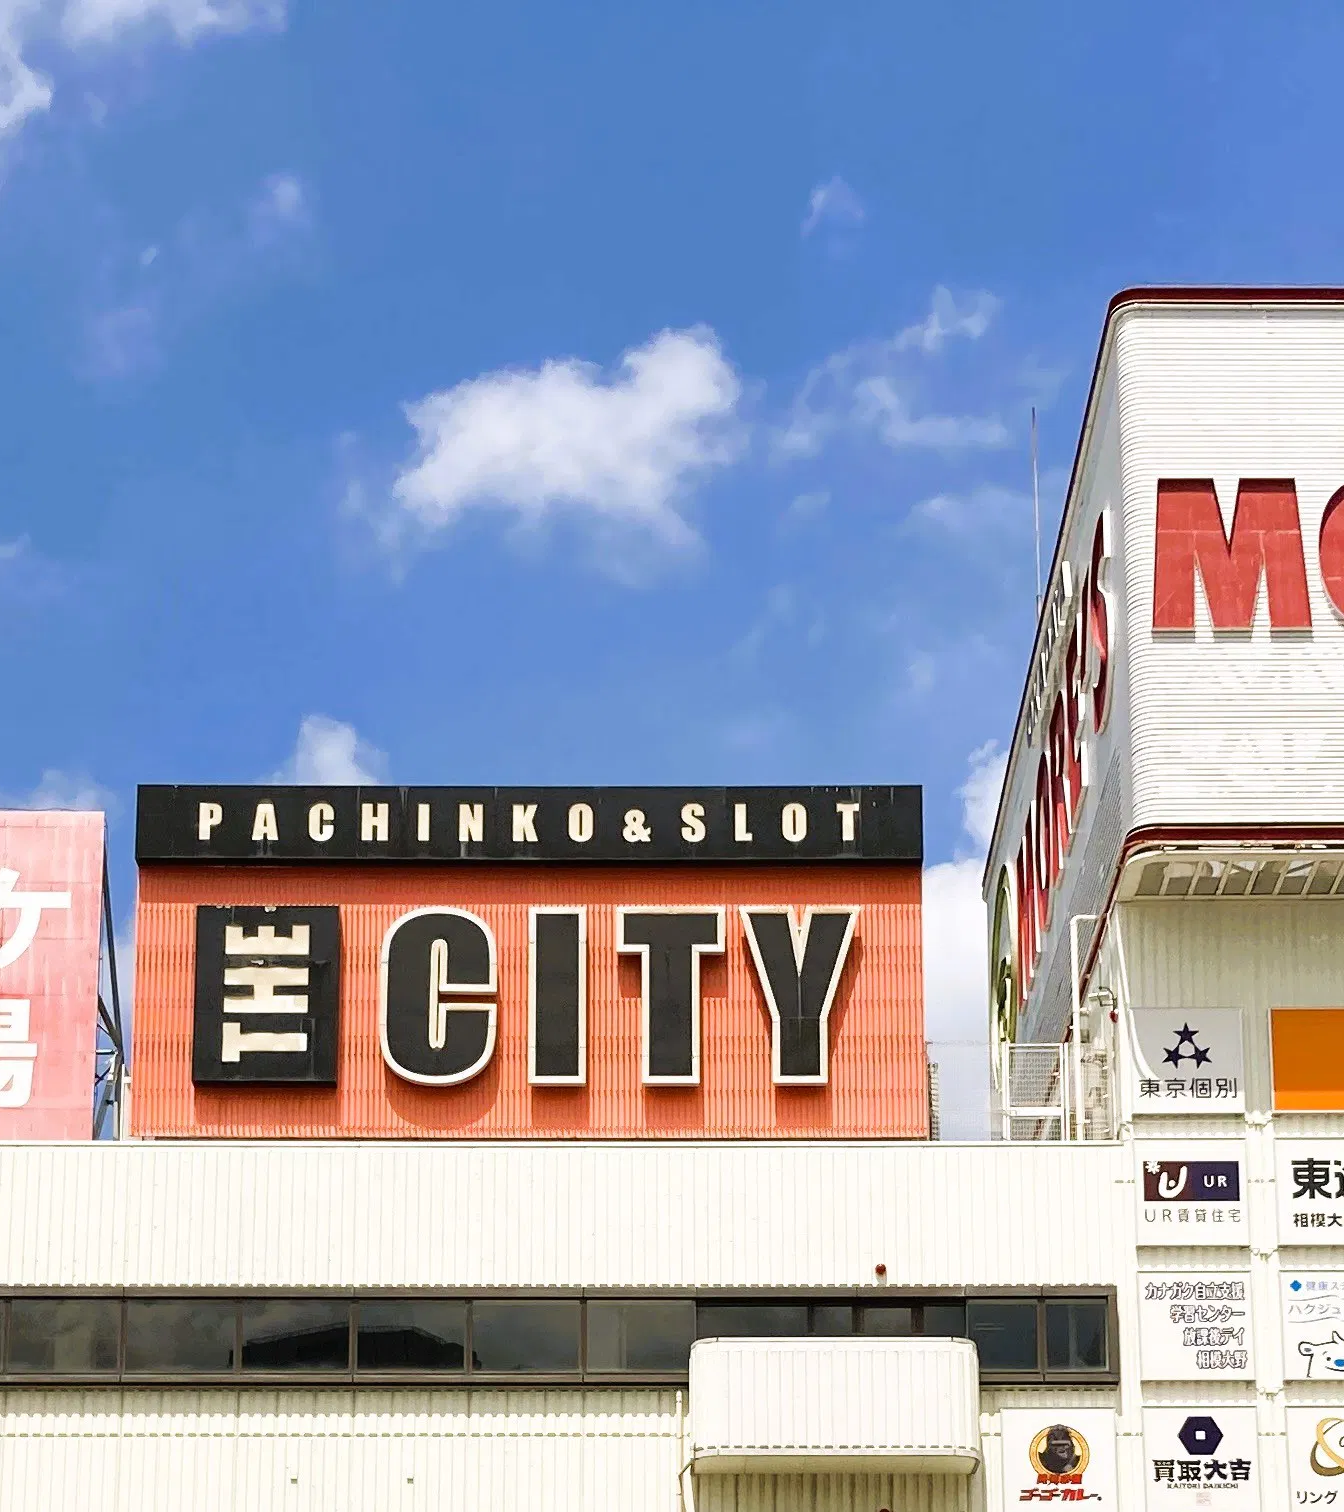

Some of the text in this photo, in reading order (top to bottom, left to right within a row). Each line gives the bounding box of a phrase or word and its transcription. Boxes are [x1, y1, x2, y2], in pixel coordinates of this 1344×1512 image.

[220, 904, 861, 1088] THE CITY
[1138, 1076, 1239, 1100] 東京個別
[1203, 1174, 1228, 1188] UR
[1144, 1208, 1242, 1224] UR賃貸住宅
[1144, 1281, 1246, 1301] カナガク自立支援
[1169, 1304, 1246, 1323] 学習センター
[1182, 1326, 1246, 1347] 放課後デイ
[1196, 1350, 1249, 1370] 相模大野
[1151, 1457, 1253, 1483] 買取大吉
[1296, 1490, 1339, 1506] リング
